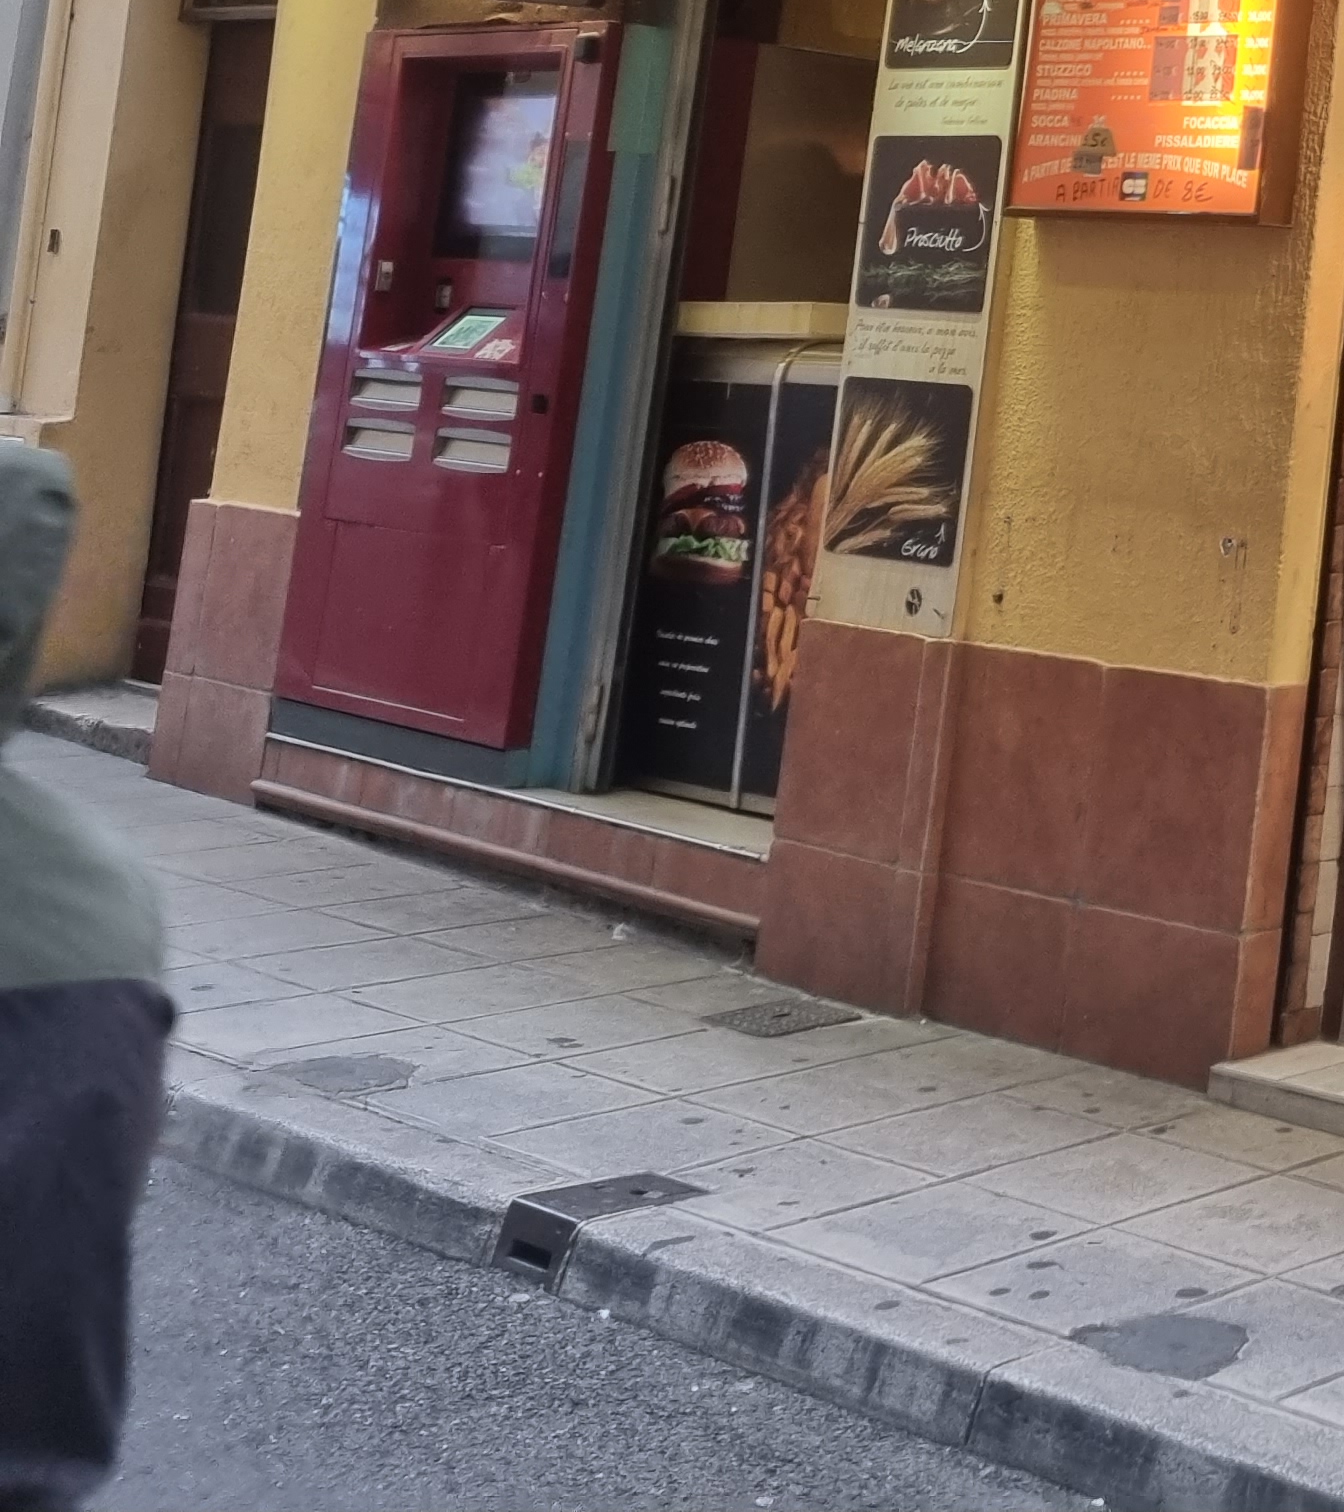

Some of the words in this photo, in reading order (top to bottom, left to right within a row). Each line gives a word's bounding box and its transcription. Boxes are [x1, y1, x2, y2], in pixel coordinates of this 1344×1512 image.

[1043, 13, 1107, 25] PRIMAVERA
[1039, 38, 1082, 50] CALZONE
[1036, 64, 1092, 76] STUZZICO
[1033, 88, 1078, 100] PIADINA
[1031, 115, 1069, 127] SOCCA
[1183, 116, 1238, 129] FOCACCIA
[1028, 134, 1081, 146] ARANCINI
[1154, 135, 1239, 148] PISSALADIERE
[1125, 153, 1135, 167] LE
[1162, 155, 1182, 173] PRIX
[1184, 158, 1200, 174] QUE
[1202, 161, 1219, 179] SUR
[1221, 165, 1248, 188] PLACE
[1056, 184, 1065, 202] A
[1154, 179, 1173, 199] DE
[904, 227, 963, 251] Prosciutto
